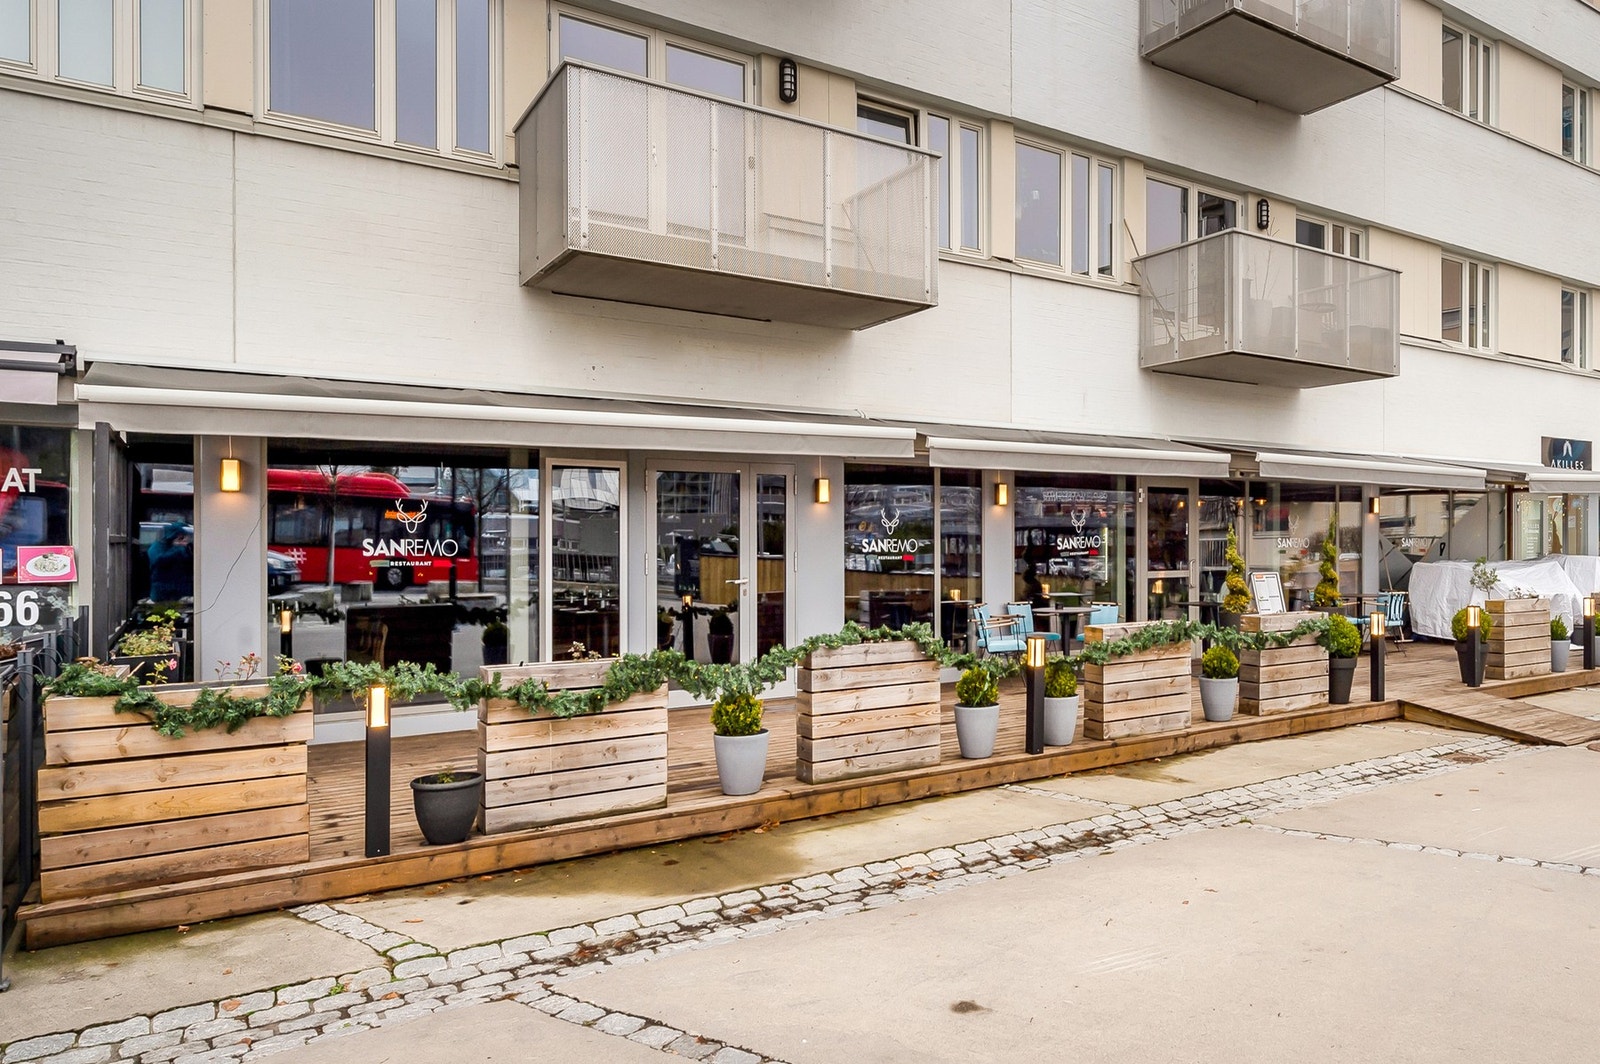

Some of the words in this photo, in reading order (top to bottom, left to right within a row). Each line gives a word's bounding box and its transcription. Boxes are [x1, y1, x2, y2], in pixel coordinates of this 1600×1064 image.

[1550, 459, 1584, 470] AKILLES
[0, 467, 42, 493] AT
[362, 538, 459, 557] SANREMO
[861, 538, 918, 553] SANREMO
[1056, 535, 1101, 550] SANREMO
